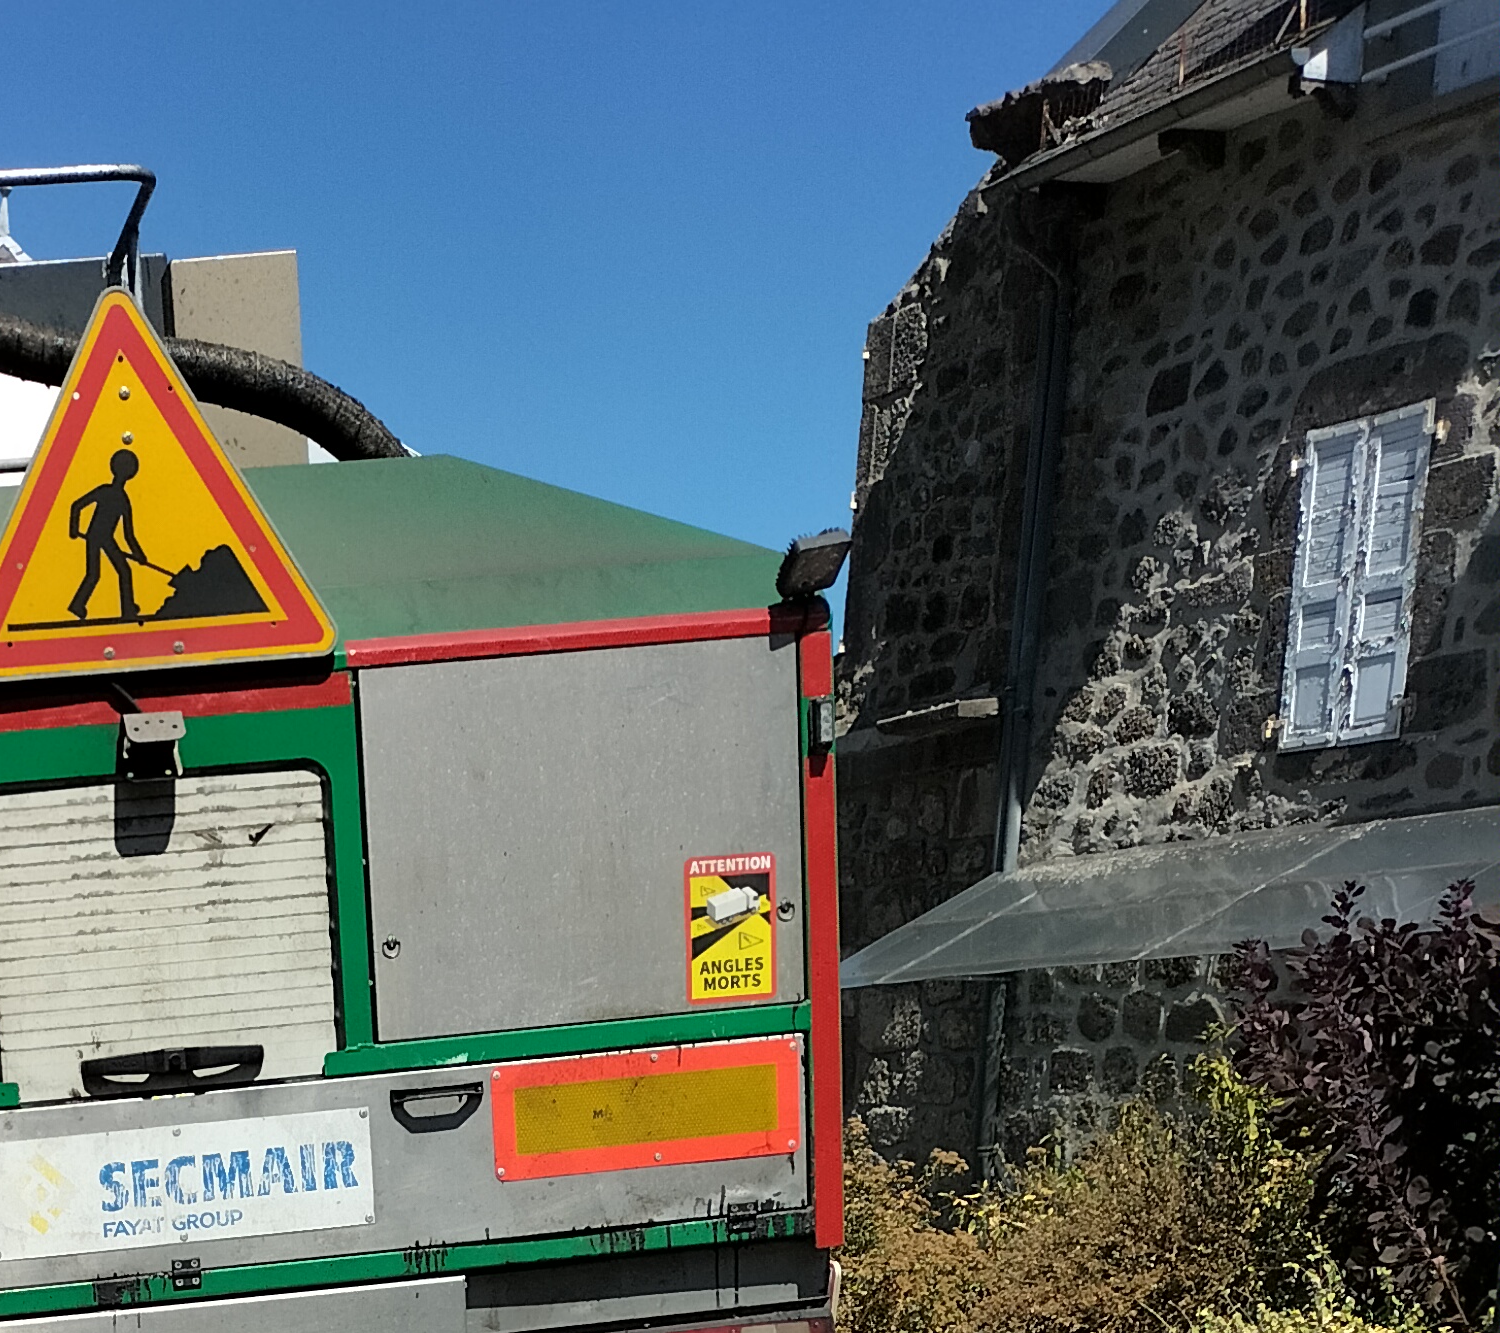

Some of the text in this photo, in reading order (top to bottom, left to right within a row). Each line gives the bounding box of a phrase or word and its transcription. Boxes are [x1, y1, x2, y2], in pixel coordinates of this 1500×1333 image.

[689, 855, 772, 875] ATTENTION
[699, 956, 764, 976] ANGLES
[703, 973, 762, 992] MORTS
[98, 1140, 360, 1213] SECMAIR
[102, 1208, 244, 1238] FAYAT GROUP
